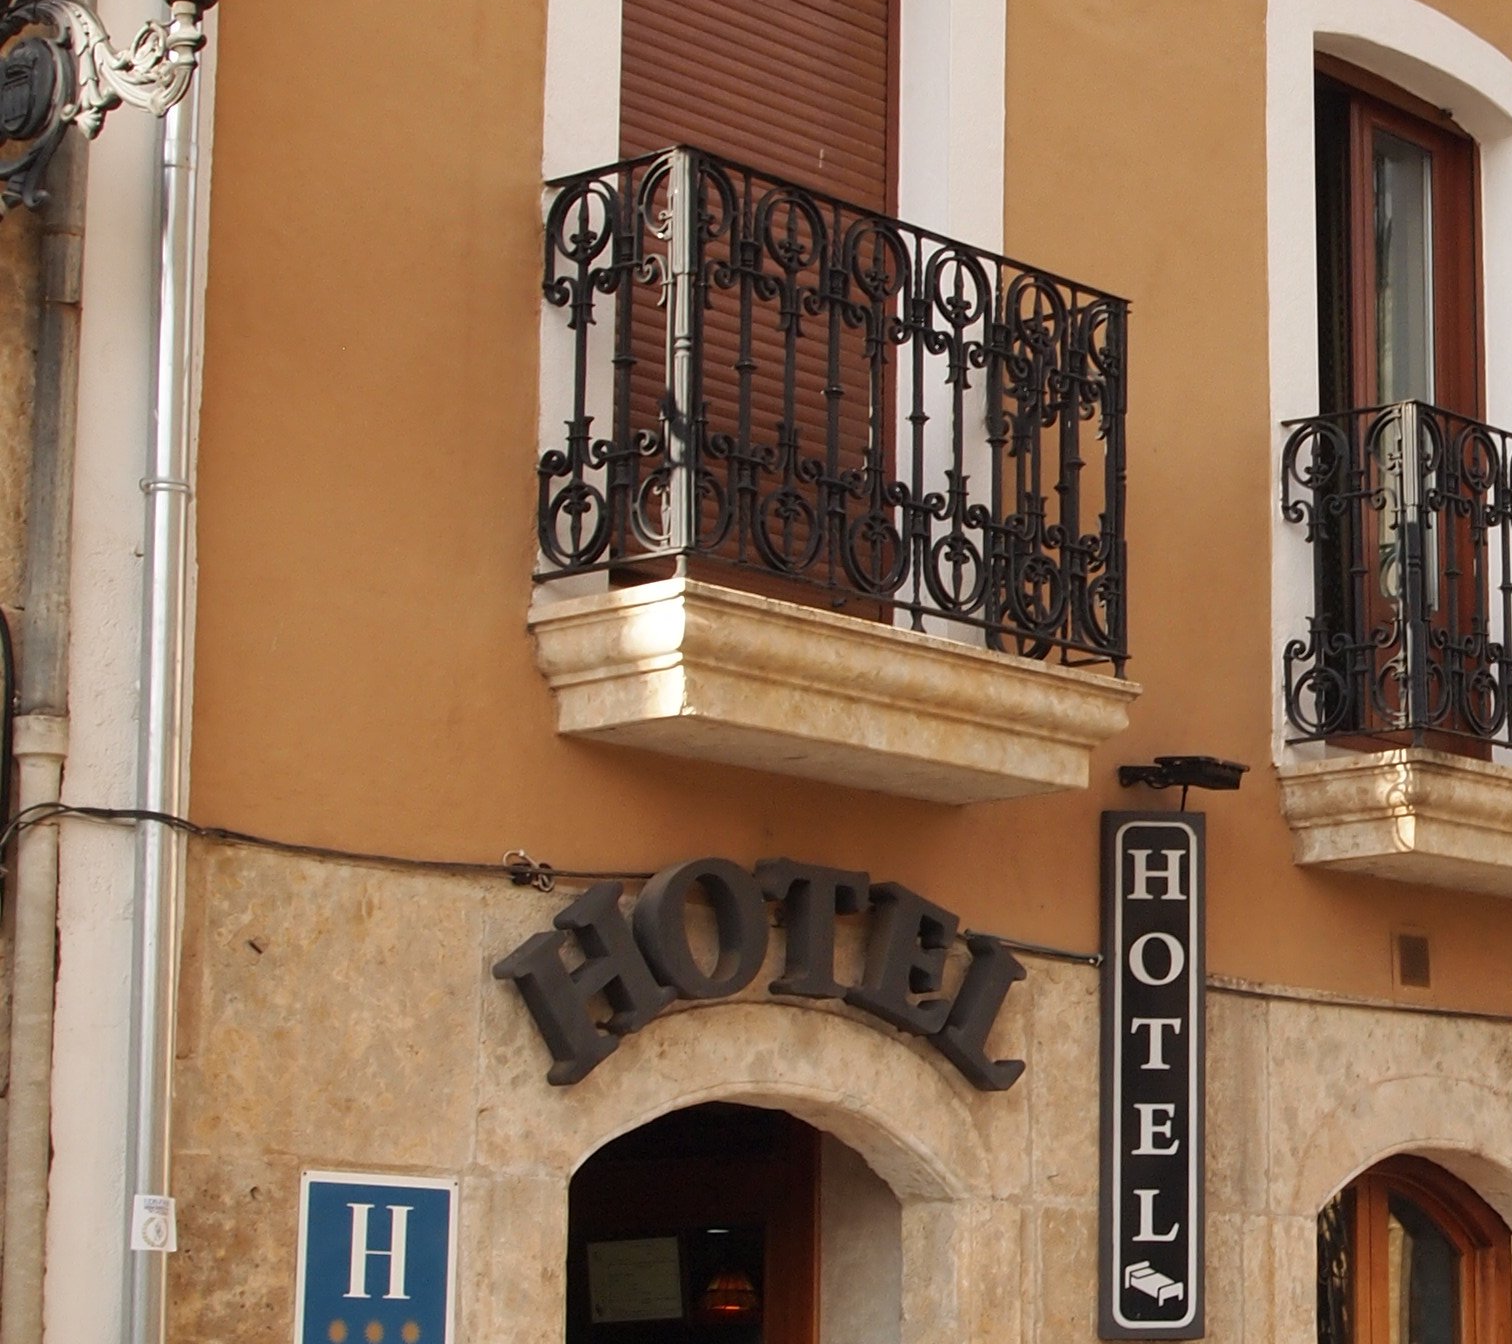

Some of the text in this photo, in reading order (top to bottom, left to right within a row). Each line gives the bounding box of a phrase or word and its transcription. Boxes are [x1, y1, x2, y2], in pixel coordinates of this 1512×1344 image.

[492, 856, 1027, 1091] HOTEL
[1127, 848, 1187, 1243] HOTEL
[342, 1202, 415, 1300] H
